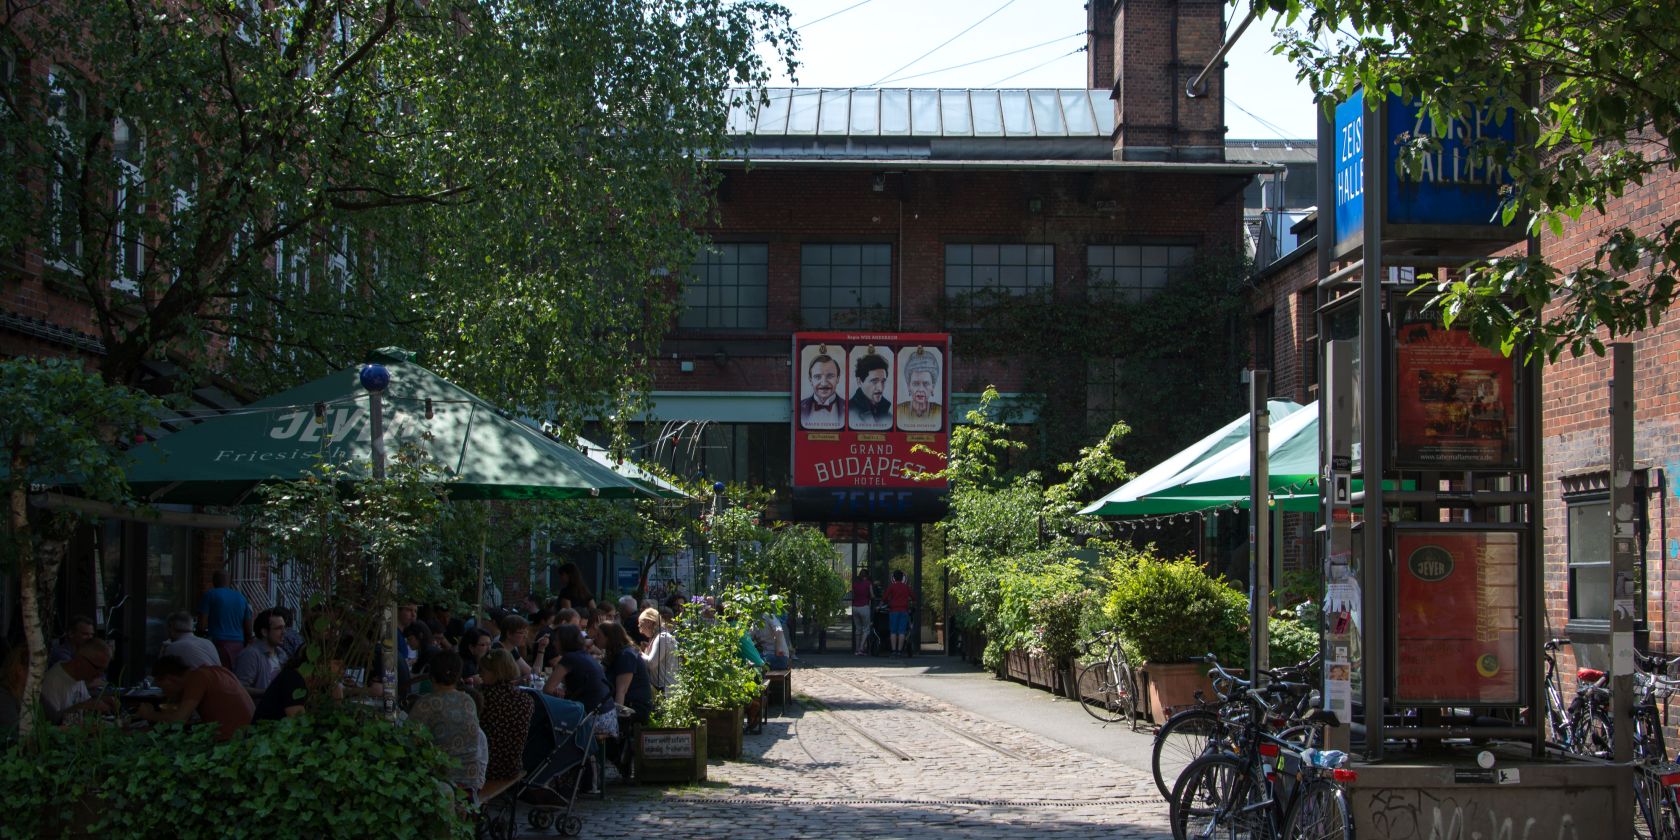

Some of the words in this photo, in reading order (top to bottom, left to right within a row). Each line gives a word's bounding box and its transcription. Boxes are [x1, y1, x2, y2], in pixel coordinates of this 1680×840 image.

[1400, 146, 1503, 184] ALLEN
[849, 444, 893, 455] GRAND
[814, 456, 926, 482] BUDAPEST
[854, 477, 887, 486] HOTEL
[831, 491, 913, 513] ZEISE
[1417, 560, 1445, 576] JEVER
